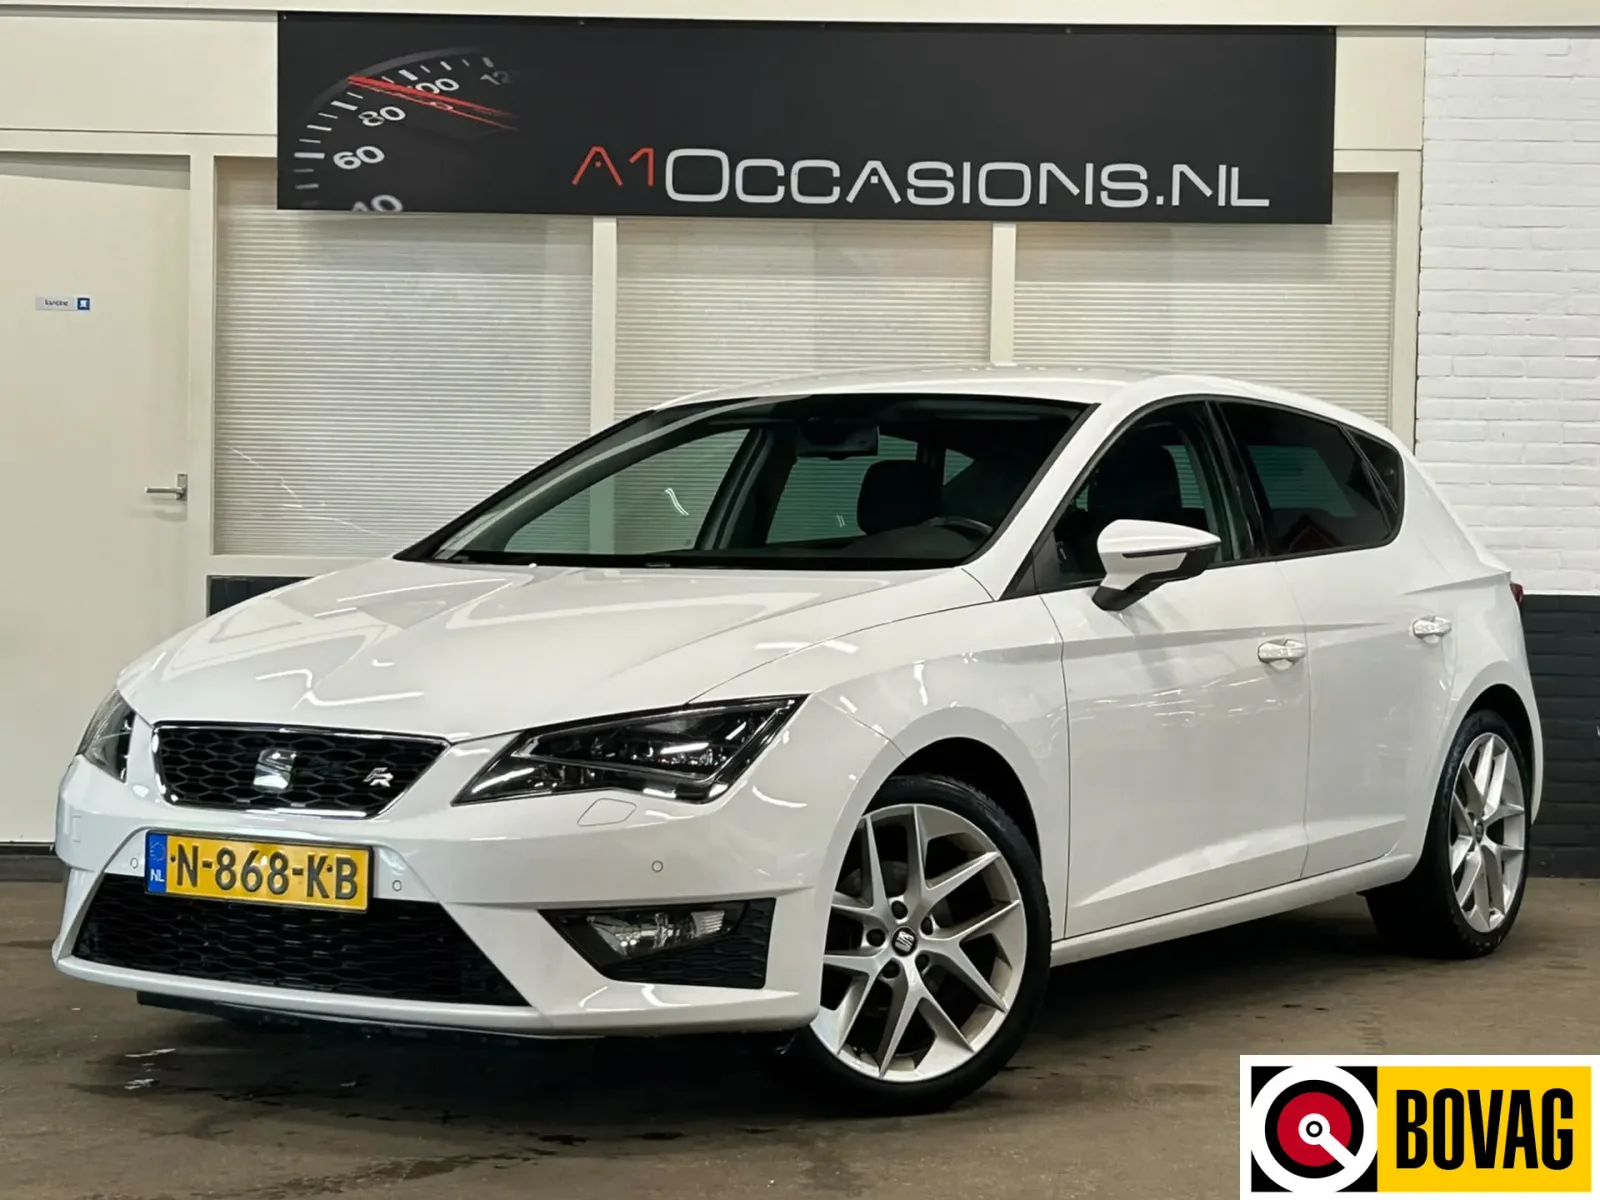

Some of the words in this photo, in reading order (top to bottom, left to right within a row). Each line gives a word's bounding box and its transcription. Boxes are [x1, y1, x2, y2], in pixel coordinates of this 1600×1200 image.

[407, 78, 460, 95] 00
[358, 106, 406, 127] 80
[333, 146, 385, 170] 60
[150, 868, 165, 882] NL
[177, 843, 358, 900] N-868-KB
